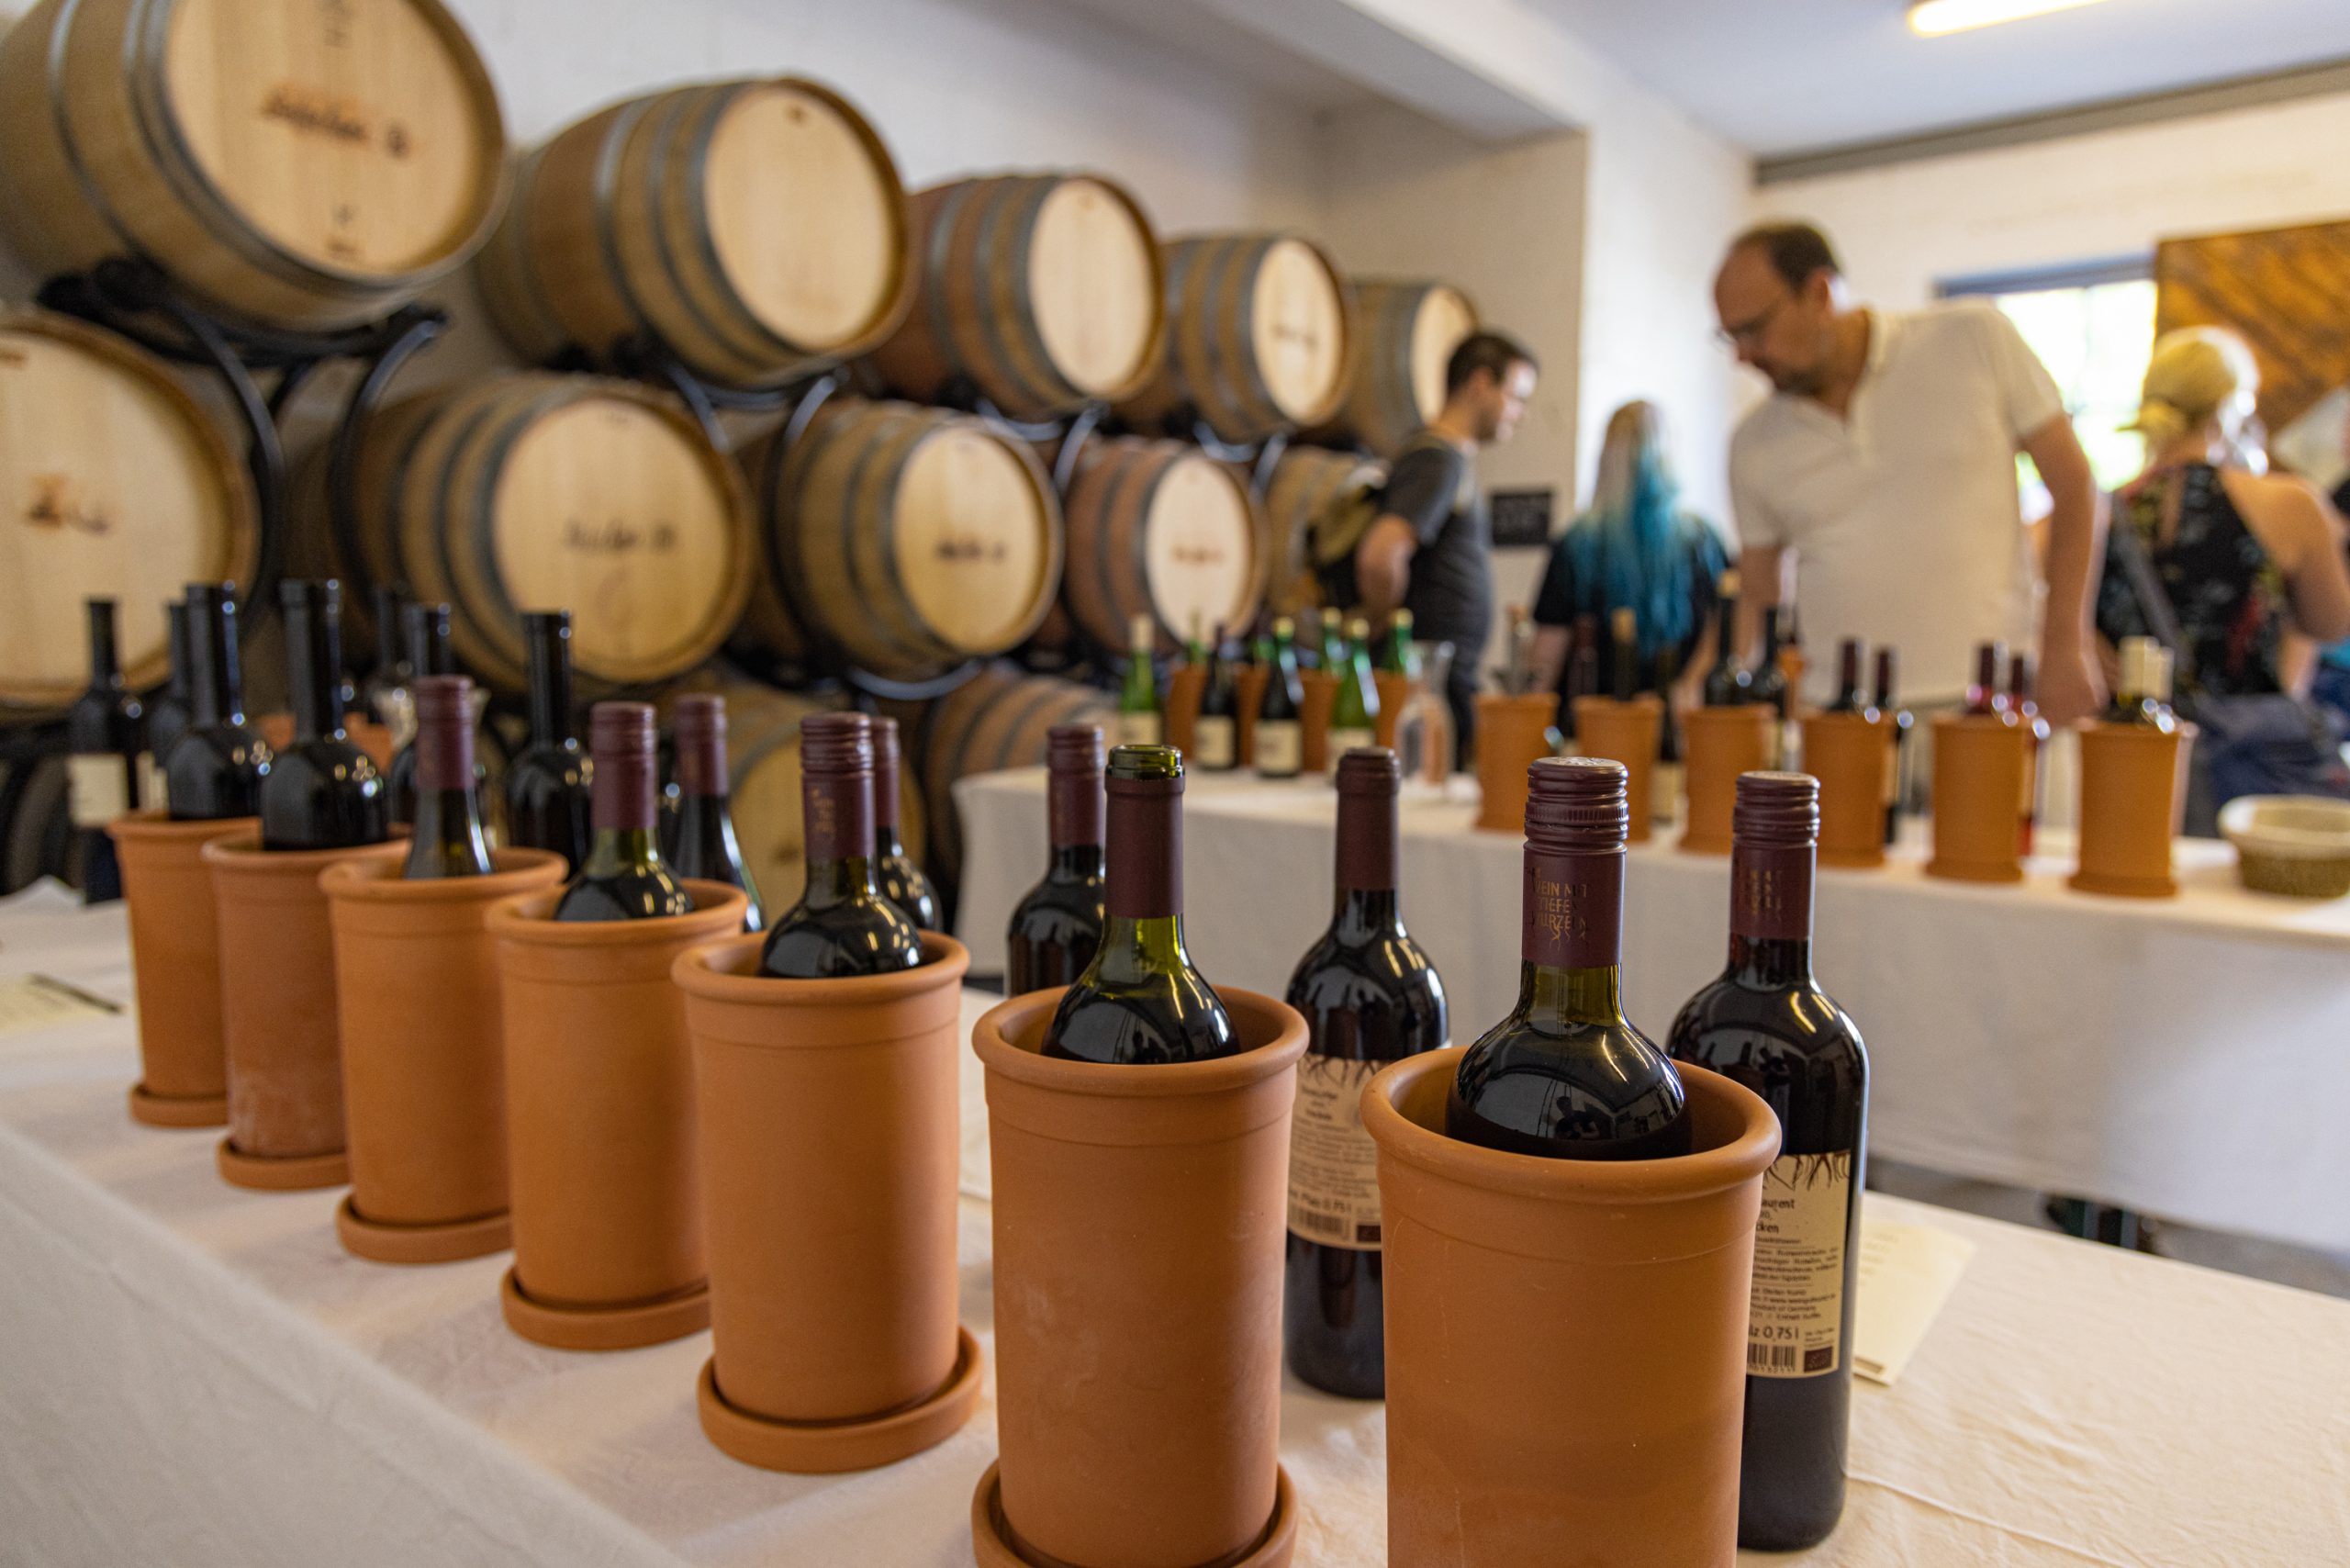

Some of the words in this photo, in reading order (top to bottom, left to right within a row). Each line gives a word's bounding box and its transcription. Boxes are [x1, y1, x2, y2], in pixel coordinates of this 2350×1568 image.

[1762, 1199, 1795, 1212] aurent
[1756, 1221, 1779, 1234] cken
[1762, 1326, 1793, 1342] 0,75
